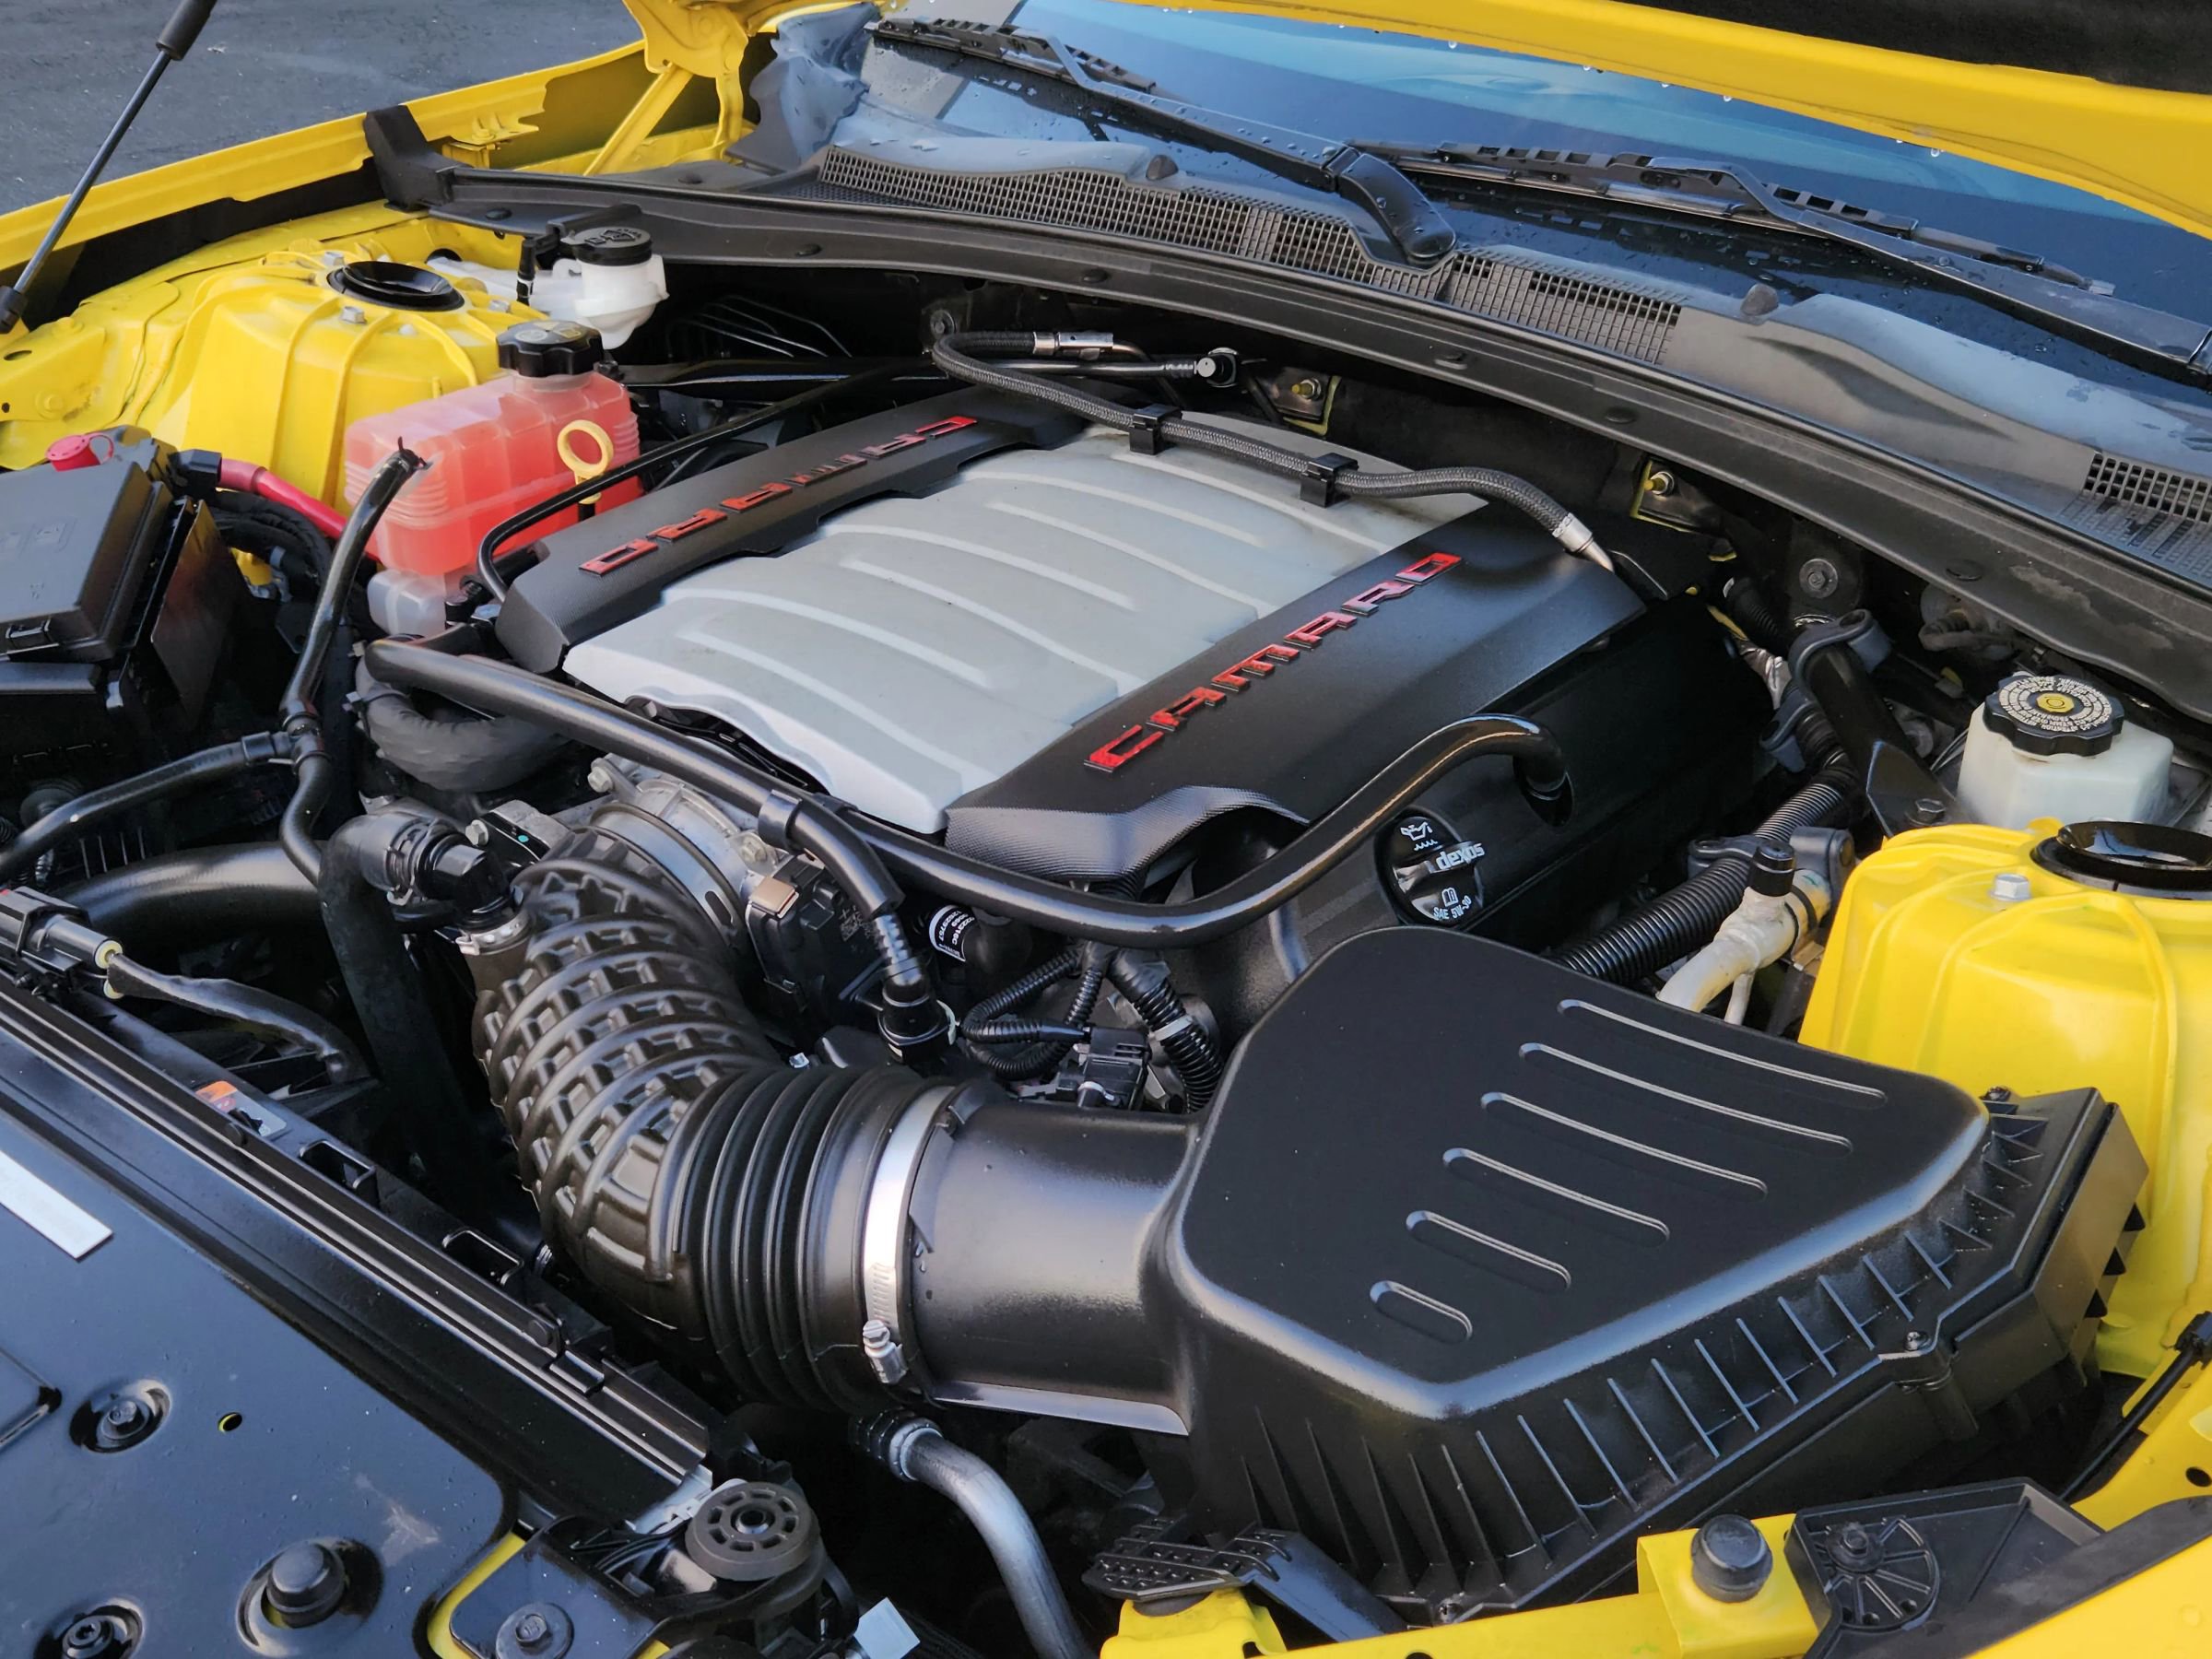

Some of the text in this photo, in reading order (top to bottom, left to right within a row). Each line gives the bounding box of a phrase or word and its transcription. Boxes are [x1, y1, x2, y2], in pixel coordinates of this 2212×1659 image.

[577, 414, 978, 577] CAMARO
[1083, 551, 1464, 773] CAMARO
[1435, 842, 1485, 870] dexos
[1433, 895, 1472, 920] SAE 5W-30
